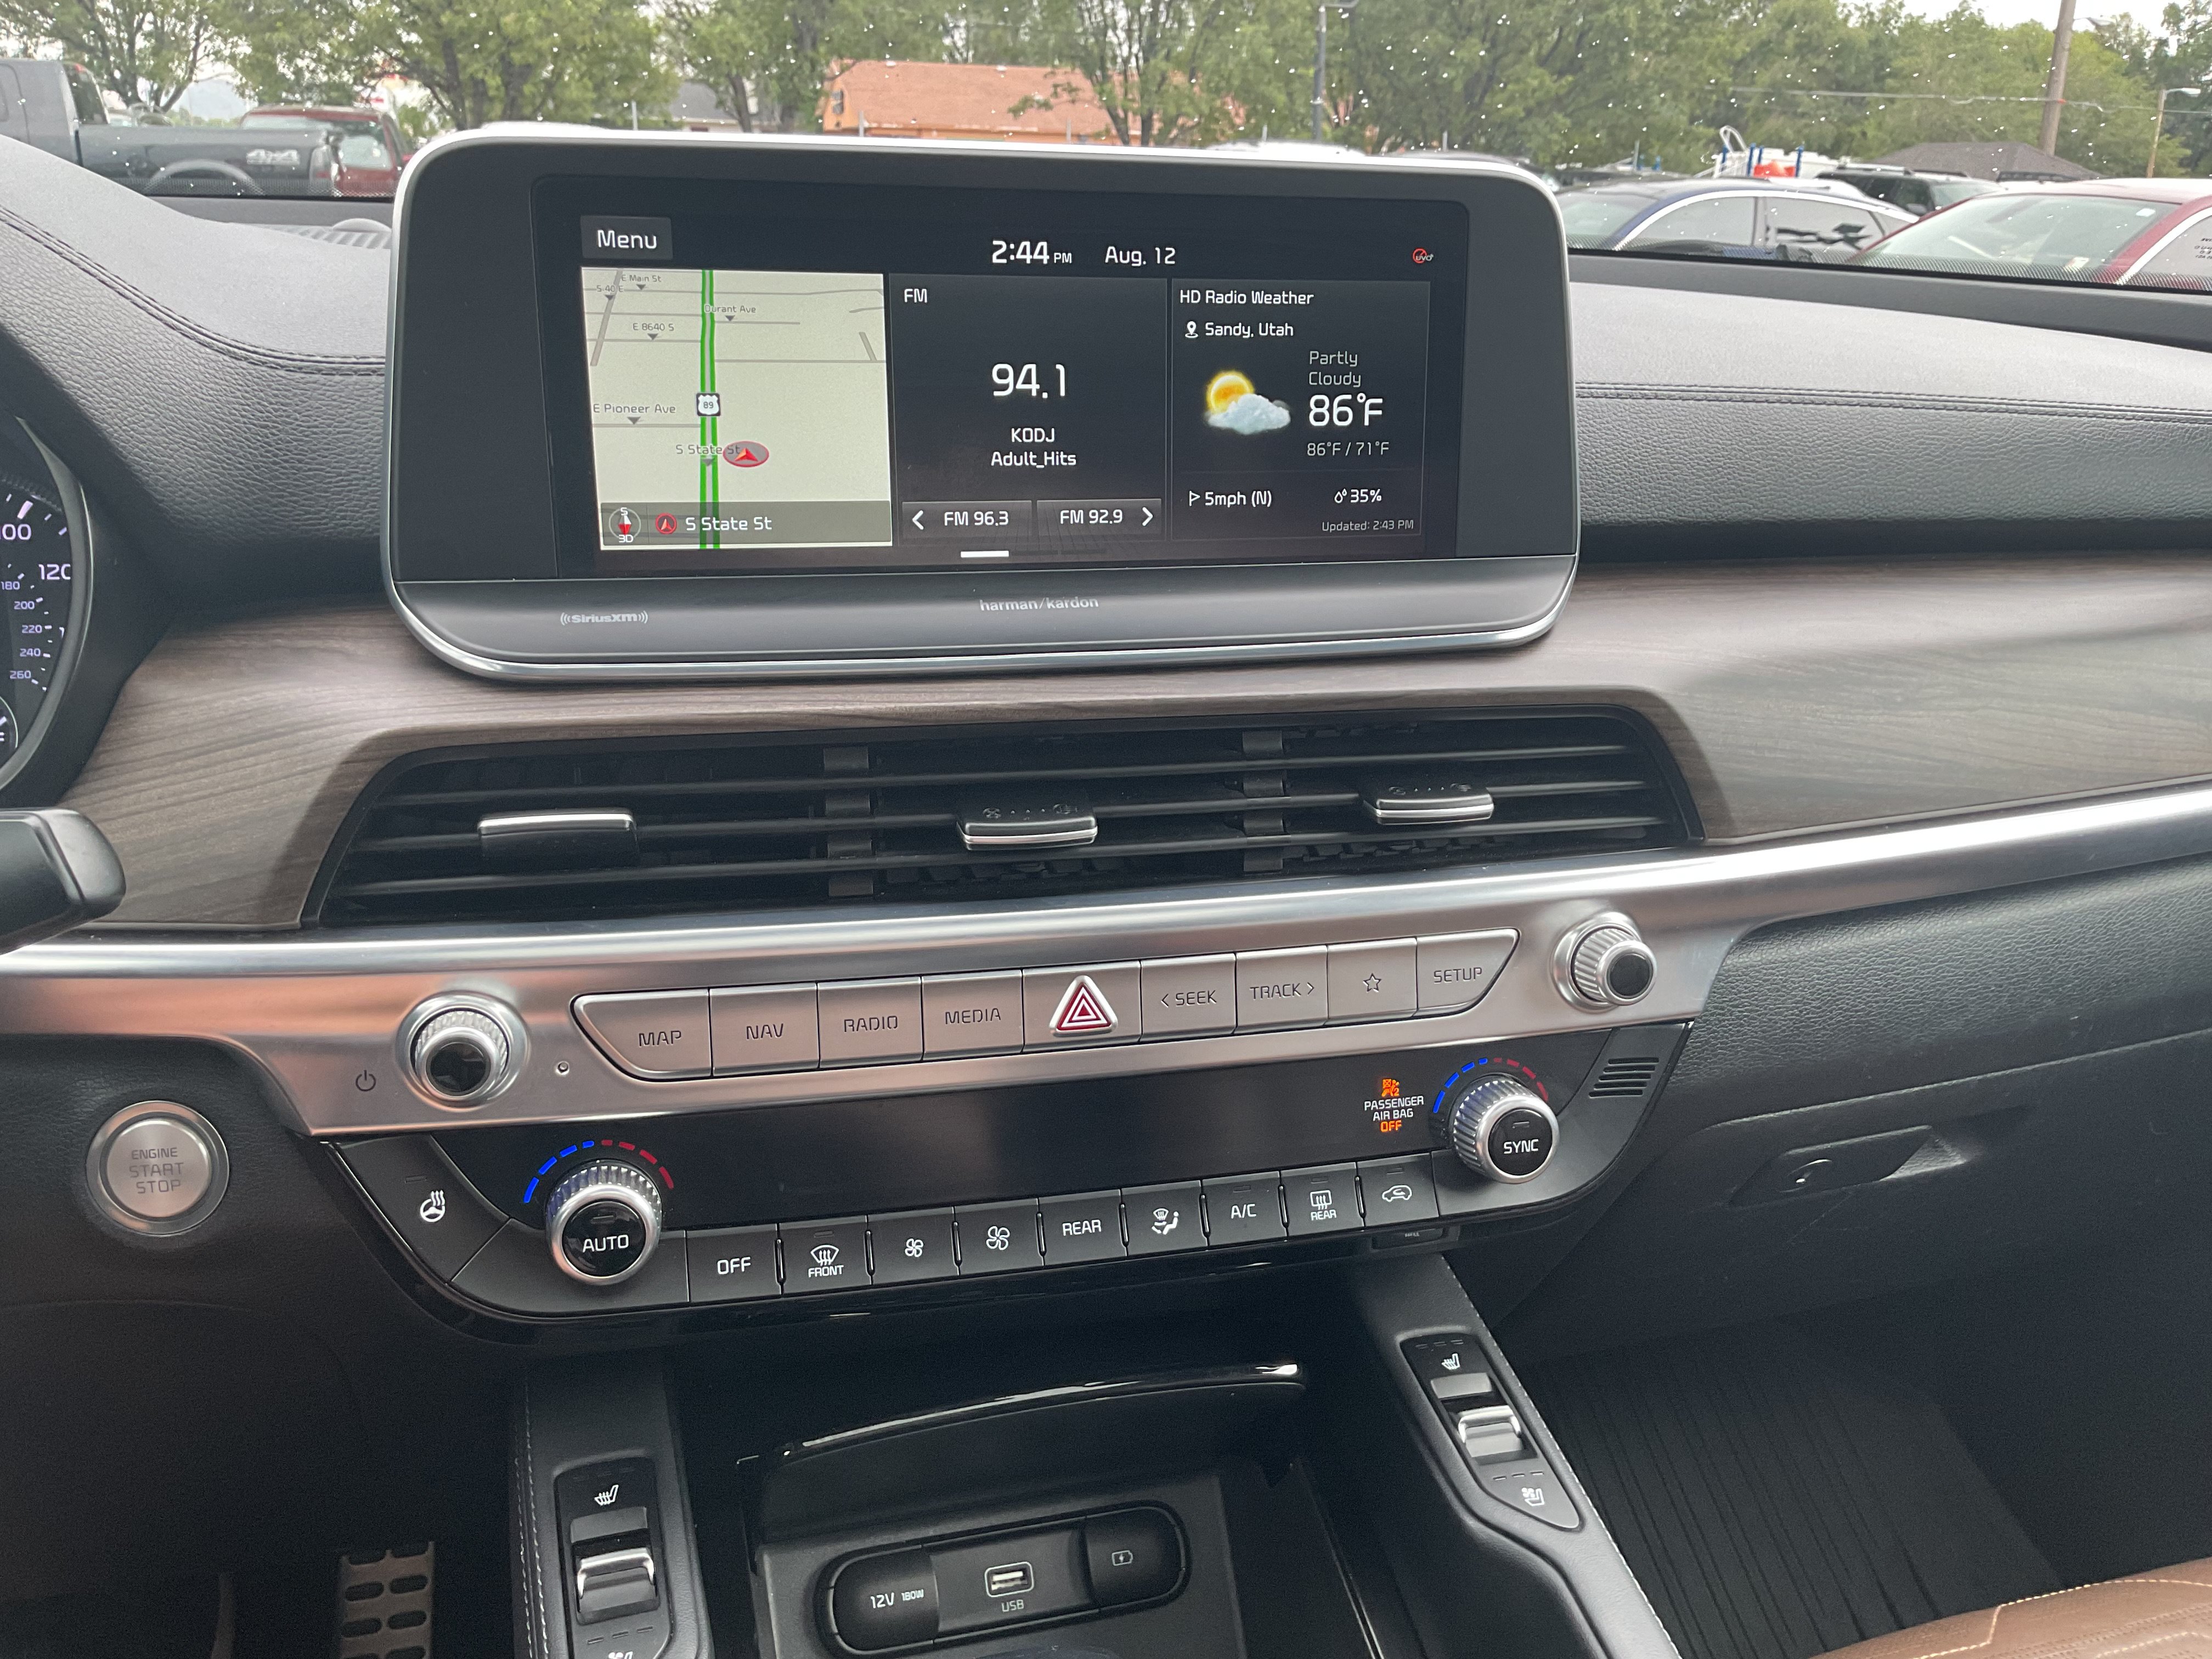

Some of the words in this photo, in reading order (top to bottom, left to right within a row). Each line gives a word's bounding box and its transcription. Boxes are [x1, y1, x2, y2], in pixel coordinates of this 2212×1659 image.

[597, 230, 657, 250] Menu
[991, 240, 1049, 264] 2:44
[1053, 252, 1072, 264] PM
[1104, 246, 1147, 266] Aug.
[1154, 247, 1176, 264] 12
[904, 289, 928, 303] FM
[1180, 290, 1200, 304] HD
[1205, 290, 1247, 304] Radio
[1251, 290, 1314, 305] Weather
[1204, 322, 1254, 339] Sandy,
[1259, 322, 1294, 337] Utah
[1309, 351, 1358, 368] Partly
[991, 363, 1067, 398] 94.1
[1309, 371, 1362, 388] Cloudy
[593, 404, 600, 413] E
[604, 404, 650, 413] Pioneer
[654, 404, 676, 414] Ave
[1309, 393, 1383, 428] 86°F
[1011, 427, 1056, 443] KODJ
[676, 445, 683, 454] S
[688, 445, 723, 454] State
[727, 444, 740, 454] St
[1306, 442, 1341, 457] 86°F
[1356, 441, 1390, 456] 71°F
[991, 451, 1076, 469] Adult_Hits
[1204, 492, 1247, 509] 5mph
[1251, 490, 1272, 507] (N)
[1350, 489, 1382, 504] 35%
[620, 507, 628, 516] S
[944, 512, 969, 527] FM
[974, 511, 1009, 526] 96.3
[1059, 510, 1084, 524] FM
[1088, 509, 1123, 524] 92.9
[0, 523, 32, 540] 00
[686, 517, 696, 531] S
[702, 517, 748, 531] State
[754, 517, 772, 531] St
[1322, 520, 1370, 534] Updated:
[1373, 519, 1396, 531] 2:43
[1399, 519, 1414, 531] PM
[618, 534, 634, 543] 3D
[1, 581, 20, 590] 180
[14, 601, 35, 610] 200
[979, 596, 1099, 611] harman/kardon
[21, 624, 43, 634] 220
[20, 648, 41, 657] 240
[9, 670, 31, 679] 260
[1433, 967, 1483, 985] SETUP
[1175, 990, 1217, 1007] SEEK
[1250, 983, 1302, 1001] TRACK
[844, 1015, 898, 1032] RADIO
[945, 1008, 1001, 1025] MEDIA
[638, 1030, 681, 1046] MAP
[746, 1023, 784, 1040] NAV
[1364, 1096, 1424, 1111] PASSENGER
[1373, 1110, 1390, 1121] AIR
[1393, 1108, 1414, 1119] BAG
[1380, 1120, 1402, 1132] OFF
[132, 1147, 178, 1160] ENGINE
[1503, 1139, 1539, 1154] SYNC
[129, 1163, 184, 1178] START
[137, 1180, 180, 1194] STOP
[1231, 1203, 1257, 1220] A/C
[1311, 1210, 1338, 1221] REAR
[1062, 1219, 1102, 1236] REAR
[582, 1234, 630, 1253] AUTO
[717, 1256, 751, 1275] OFF
[808, 1264, 844, 1278] FRONT
[870, 1592, 895, 1609] 12V
[901, 1589, 924, 1601] 180W
[1001, 1599, 1024, 1612] USB
